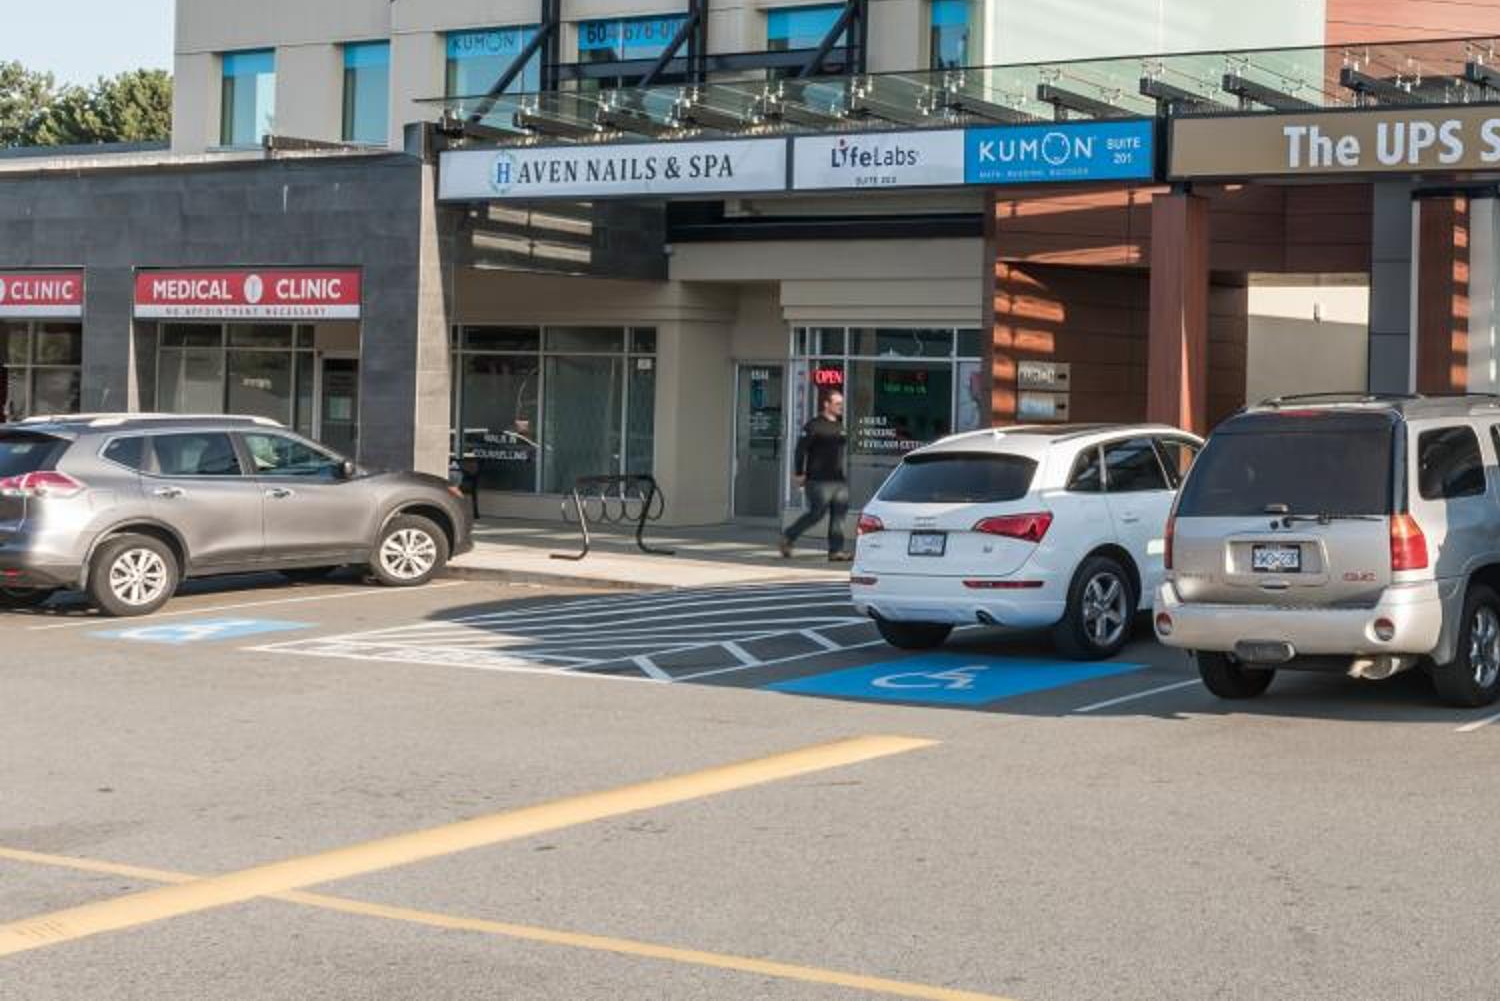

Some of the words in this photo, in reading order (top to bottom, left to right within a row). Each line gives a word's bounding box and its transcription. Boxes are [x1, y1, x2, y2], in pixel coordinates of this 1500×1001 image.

[830, 139, 919, 168] LifeLabs
[979, 131, 1095, 166] KUMON
[1106, 137, 1141, 150] SUITE
[1283, 125, 1361, 168] The
[1376, 119, 1464, 165] UPS
[496, 159, 578, 185] HAVEN
[586, 156, 657, 182] NAILS
[663, 156, 681, 180] &
[688, 153, 734, 179] SPA
[1113, 152, 1132, 165] 201
[10, 280, 74, 300] CLINIC
[152, 278, 233, 300] MEDICAL
[275, 277, 342, 299] CLINIC
[814, 369, 844, 385] OPEN
